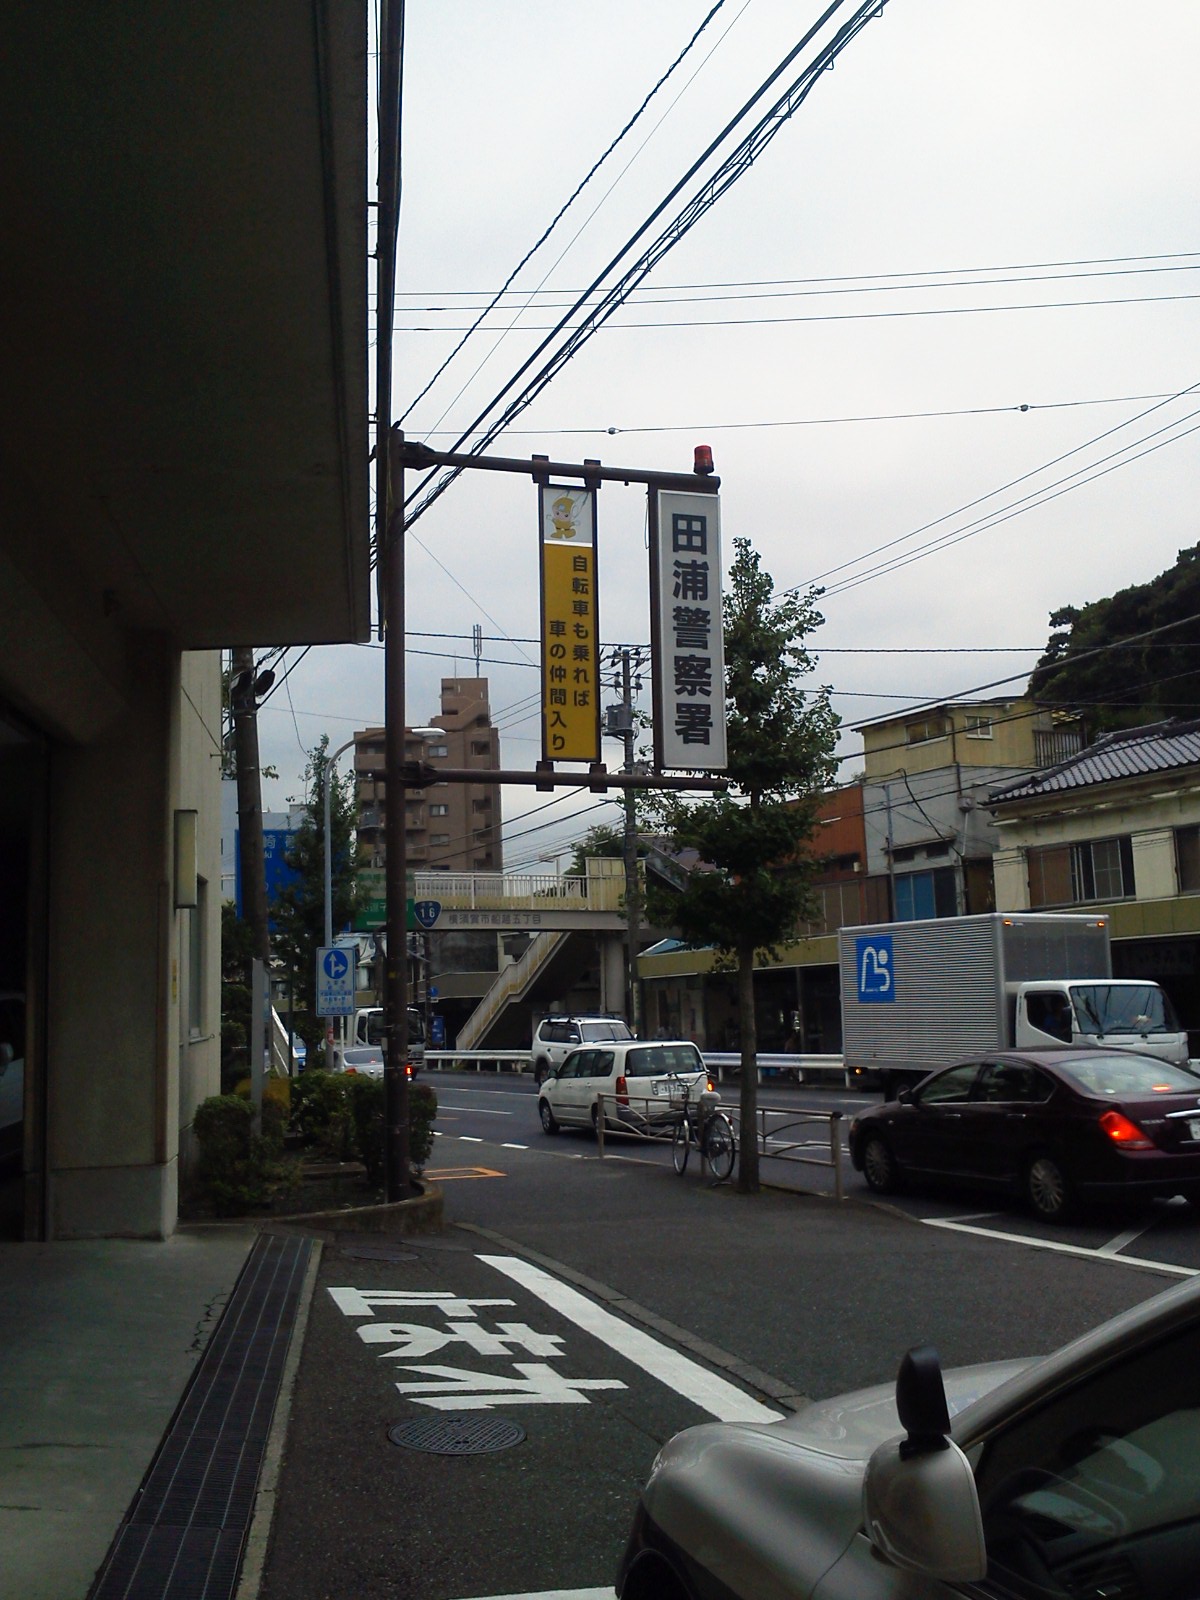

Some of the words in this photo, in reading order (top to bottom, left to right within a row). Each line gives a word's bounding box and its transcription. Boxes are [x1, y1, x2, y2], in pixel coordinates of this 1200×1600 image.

[548, 620, 568, 751] 車の仲間入り
[571, 554, 590, 708] 自転車も乗れば
[672, 512, 714, 746] 田浦警察署
[420, 907, 436, 919] 16
[449, 913, 542, 925] 横須賀市船越五丁目
[326, 1286, 629, 1411] 止まれ
